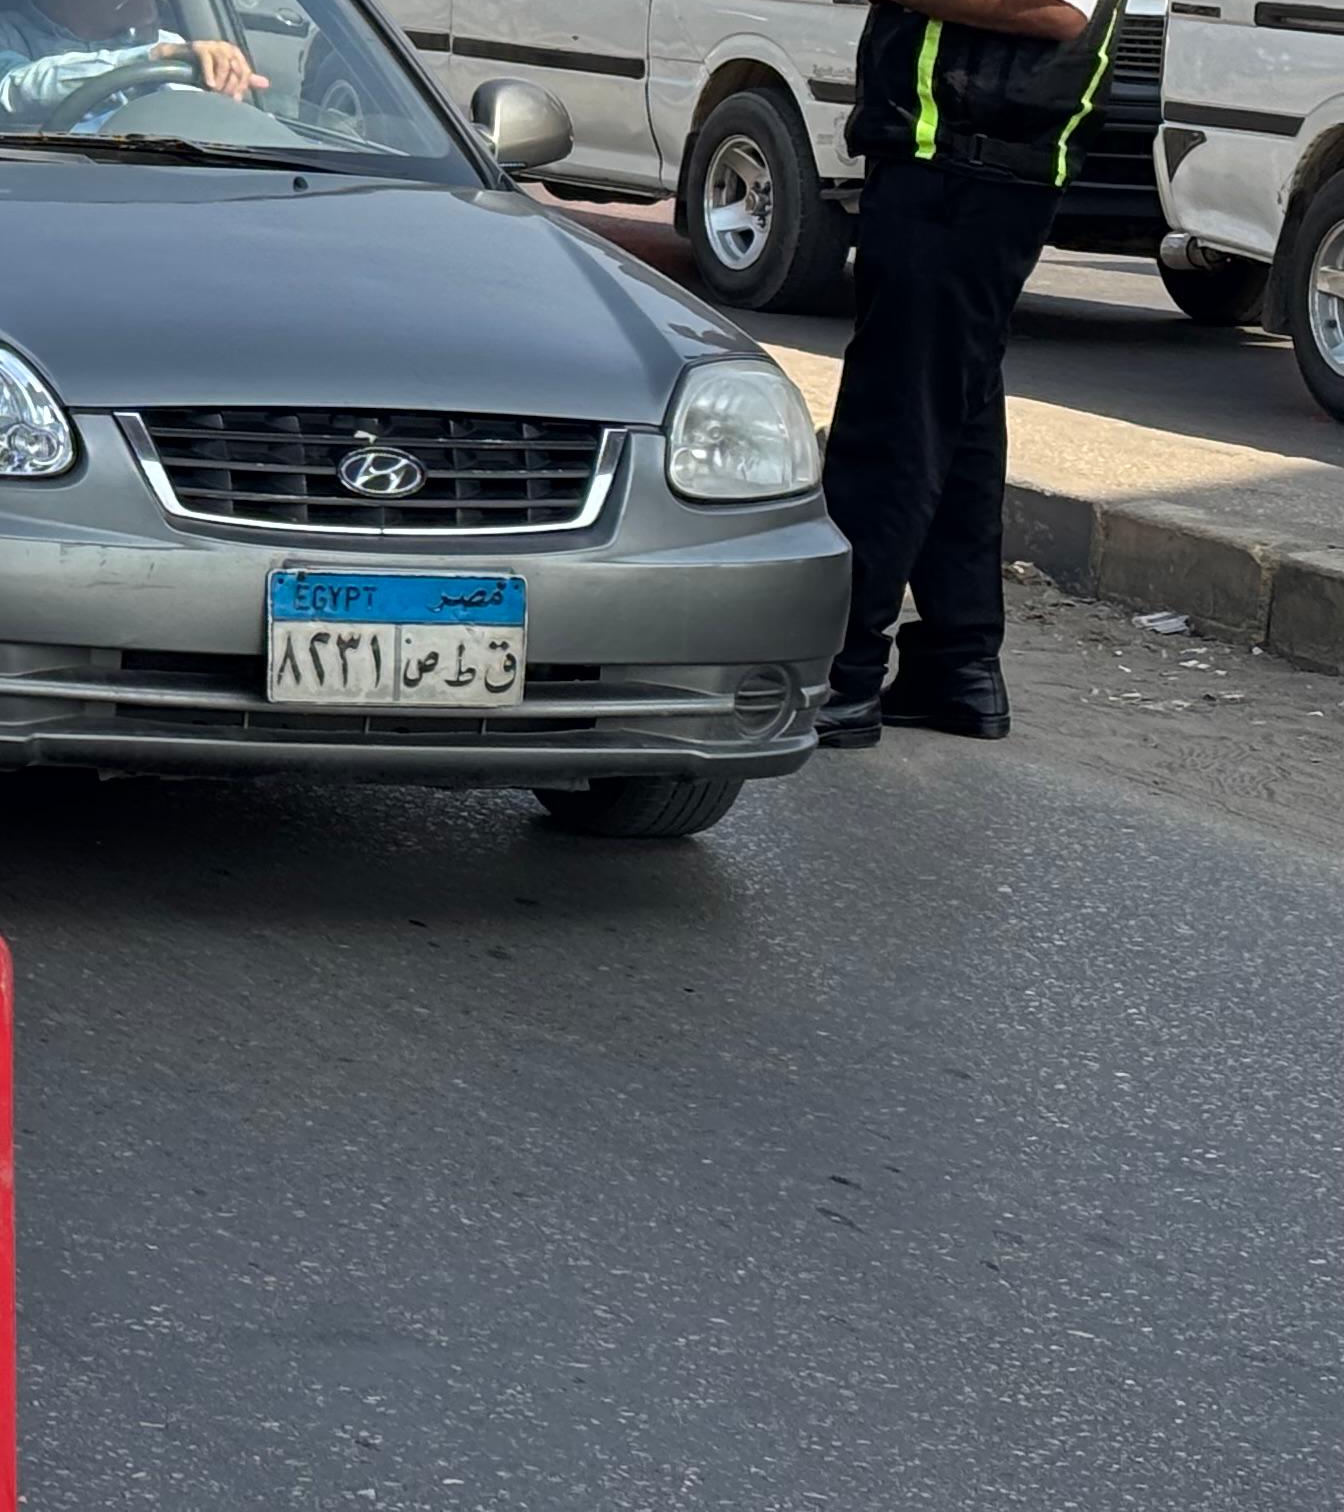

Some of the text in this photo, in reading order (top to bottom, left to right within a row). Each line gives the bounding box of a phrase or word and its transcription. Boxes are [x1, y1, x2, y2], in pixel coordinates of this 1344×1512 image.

[295, 583, 378, 611] EGYPT
[425, 589, 504, 614] مصر
[276, 631, 382, 689] ٨٢٣١
